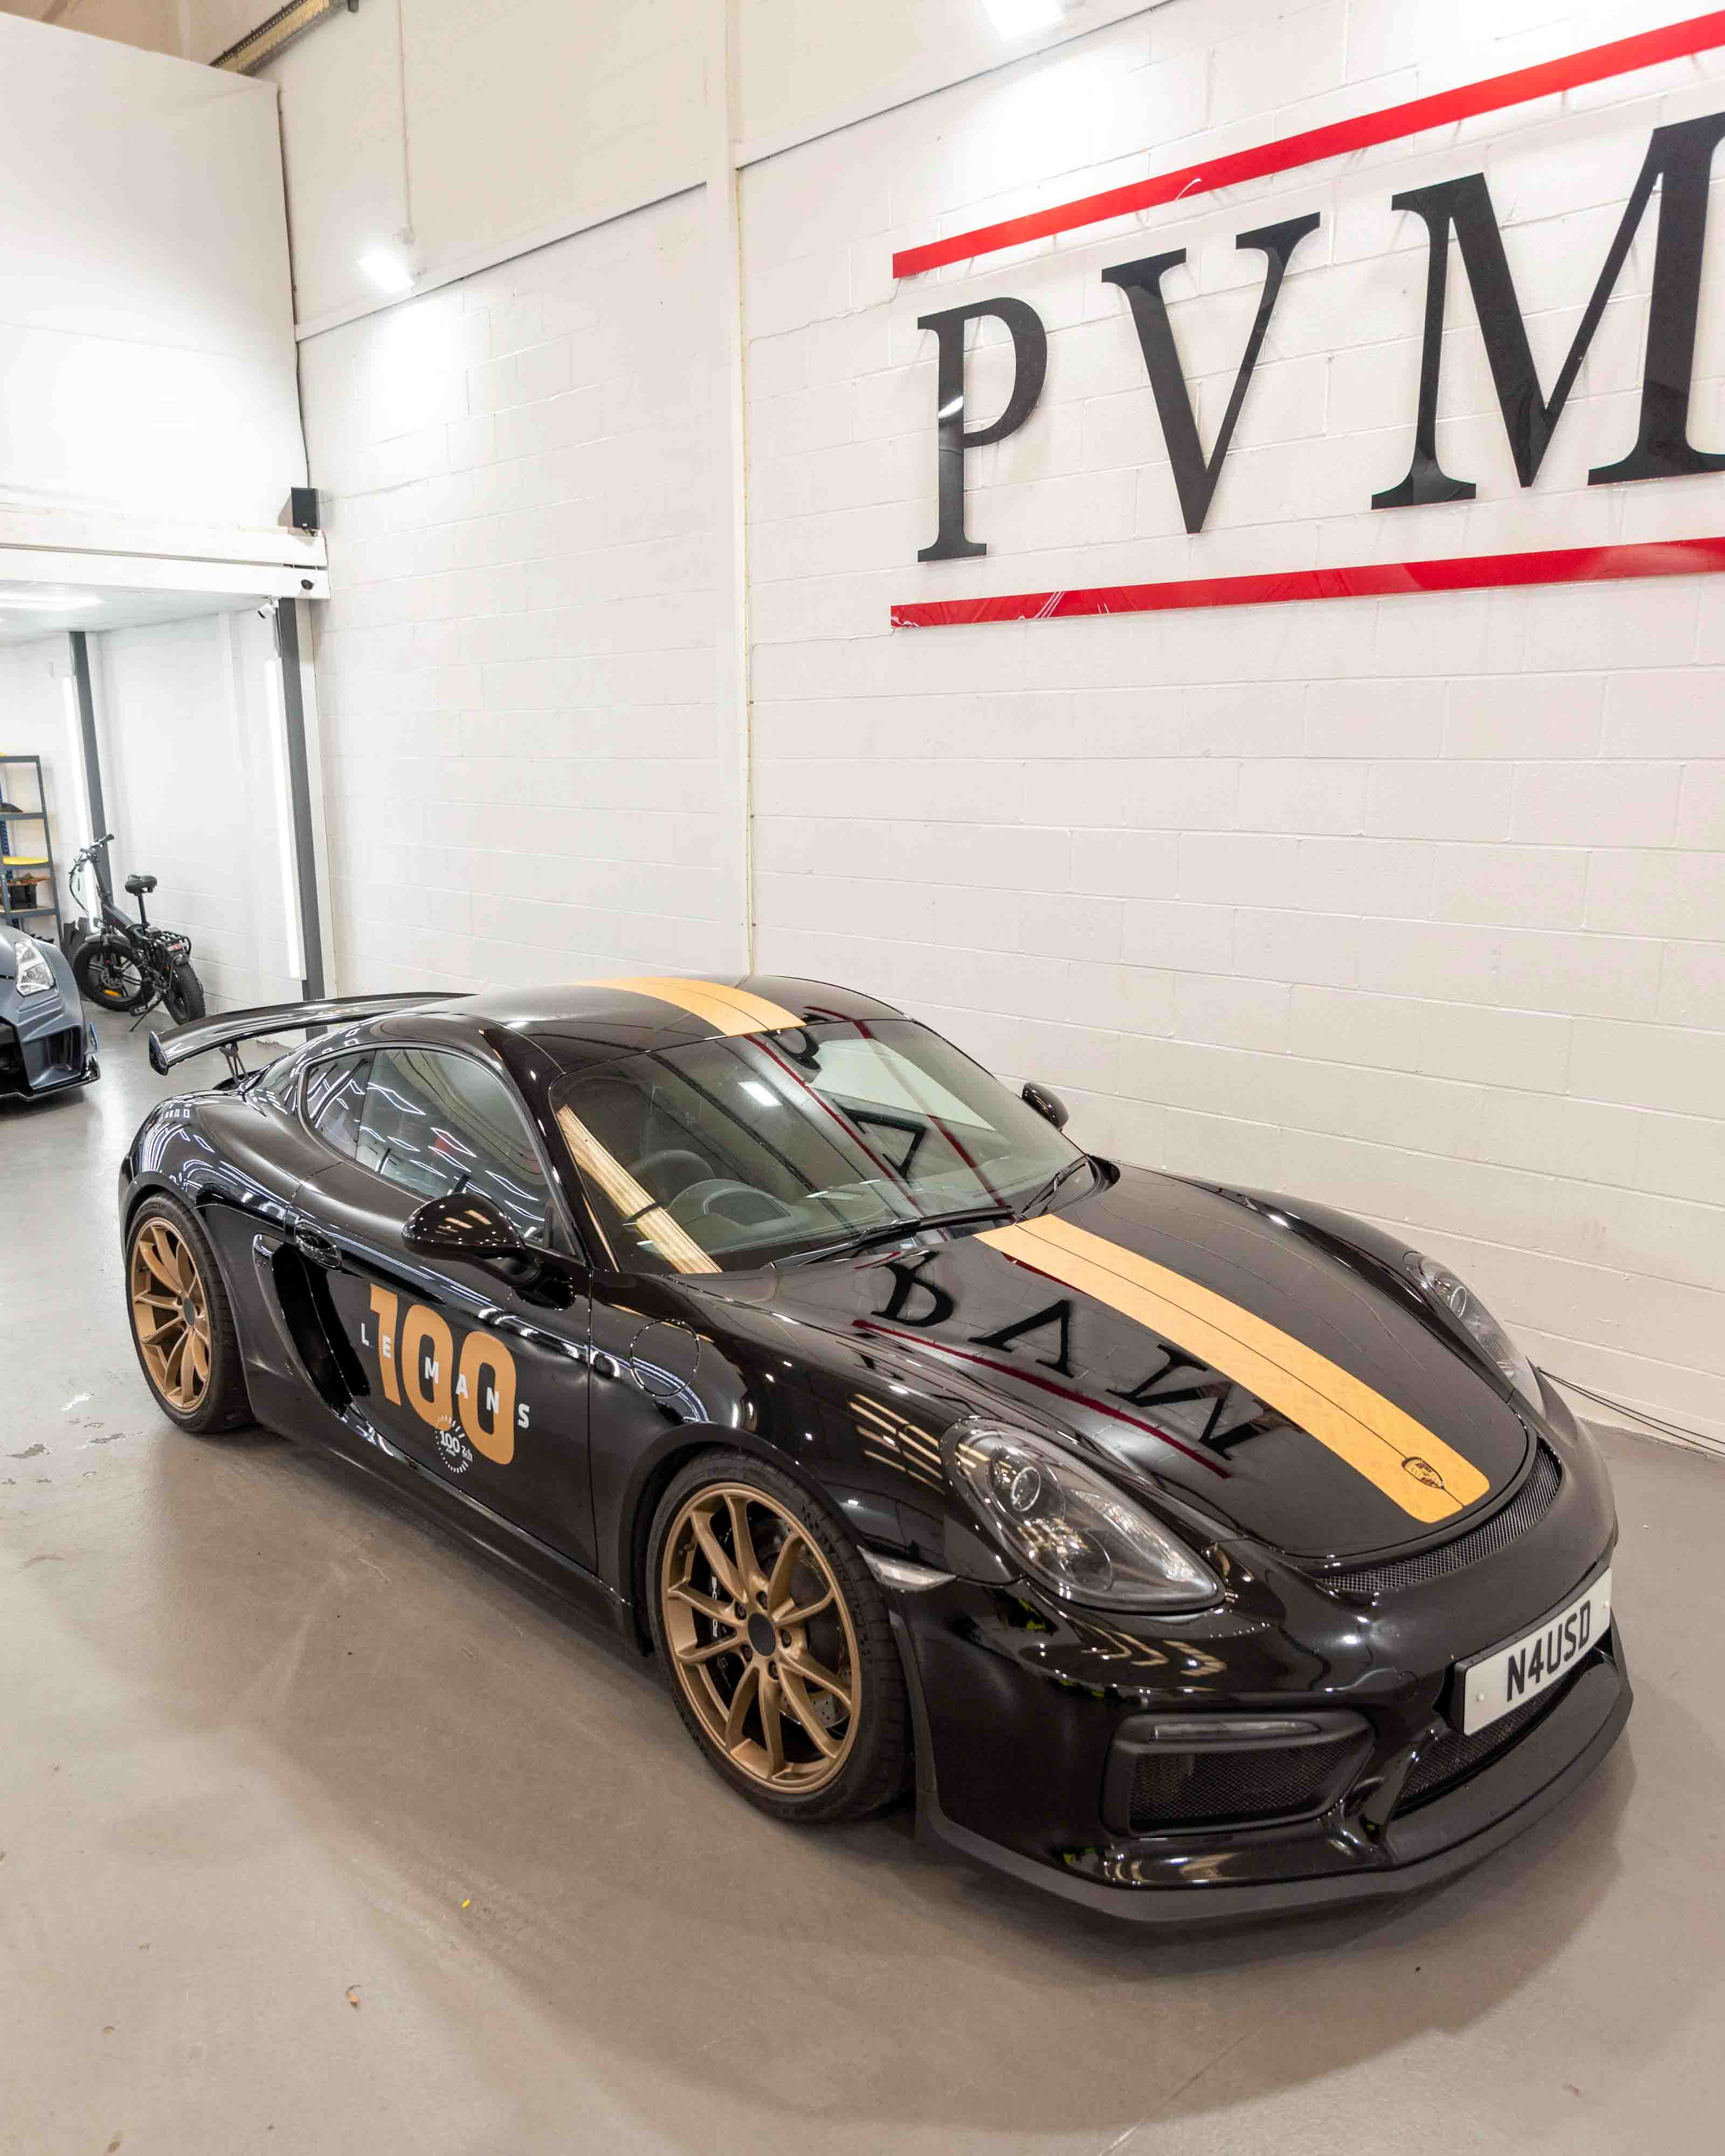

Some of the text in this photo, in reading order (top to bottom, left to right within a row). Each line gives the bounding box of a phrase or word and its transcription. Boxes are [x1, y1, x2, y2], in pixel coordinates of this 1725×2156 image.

[361, 1322, 530, 1429] LE MANS
[370, 1283, 517, 1466] 100
[439, 1430, 460, 1453] 100
[1507, 1599, 1591, 1703] N4USD
